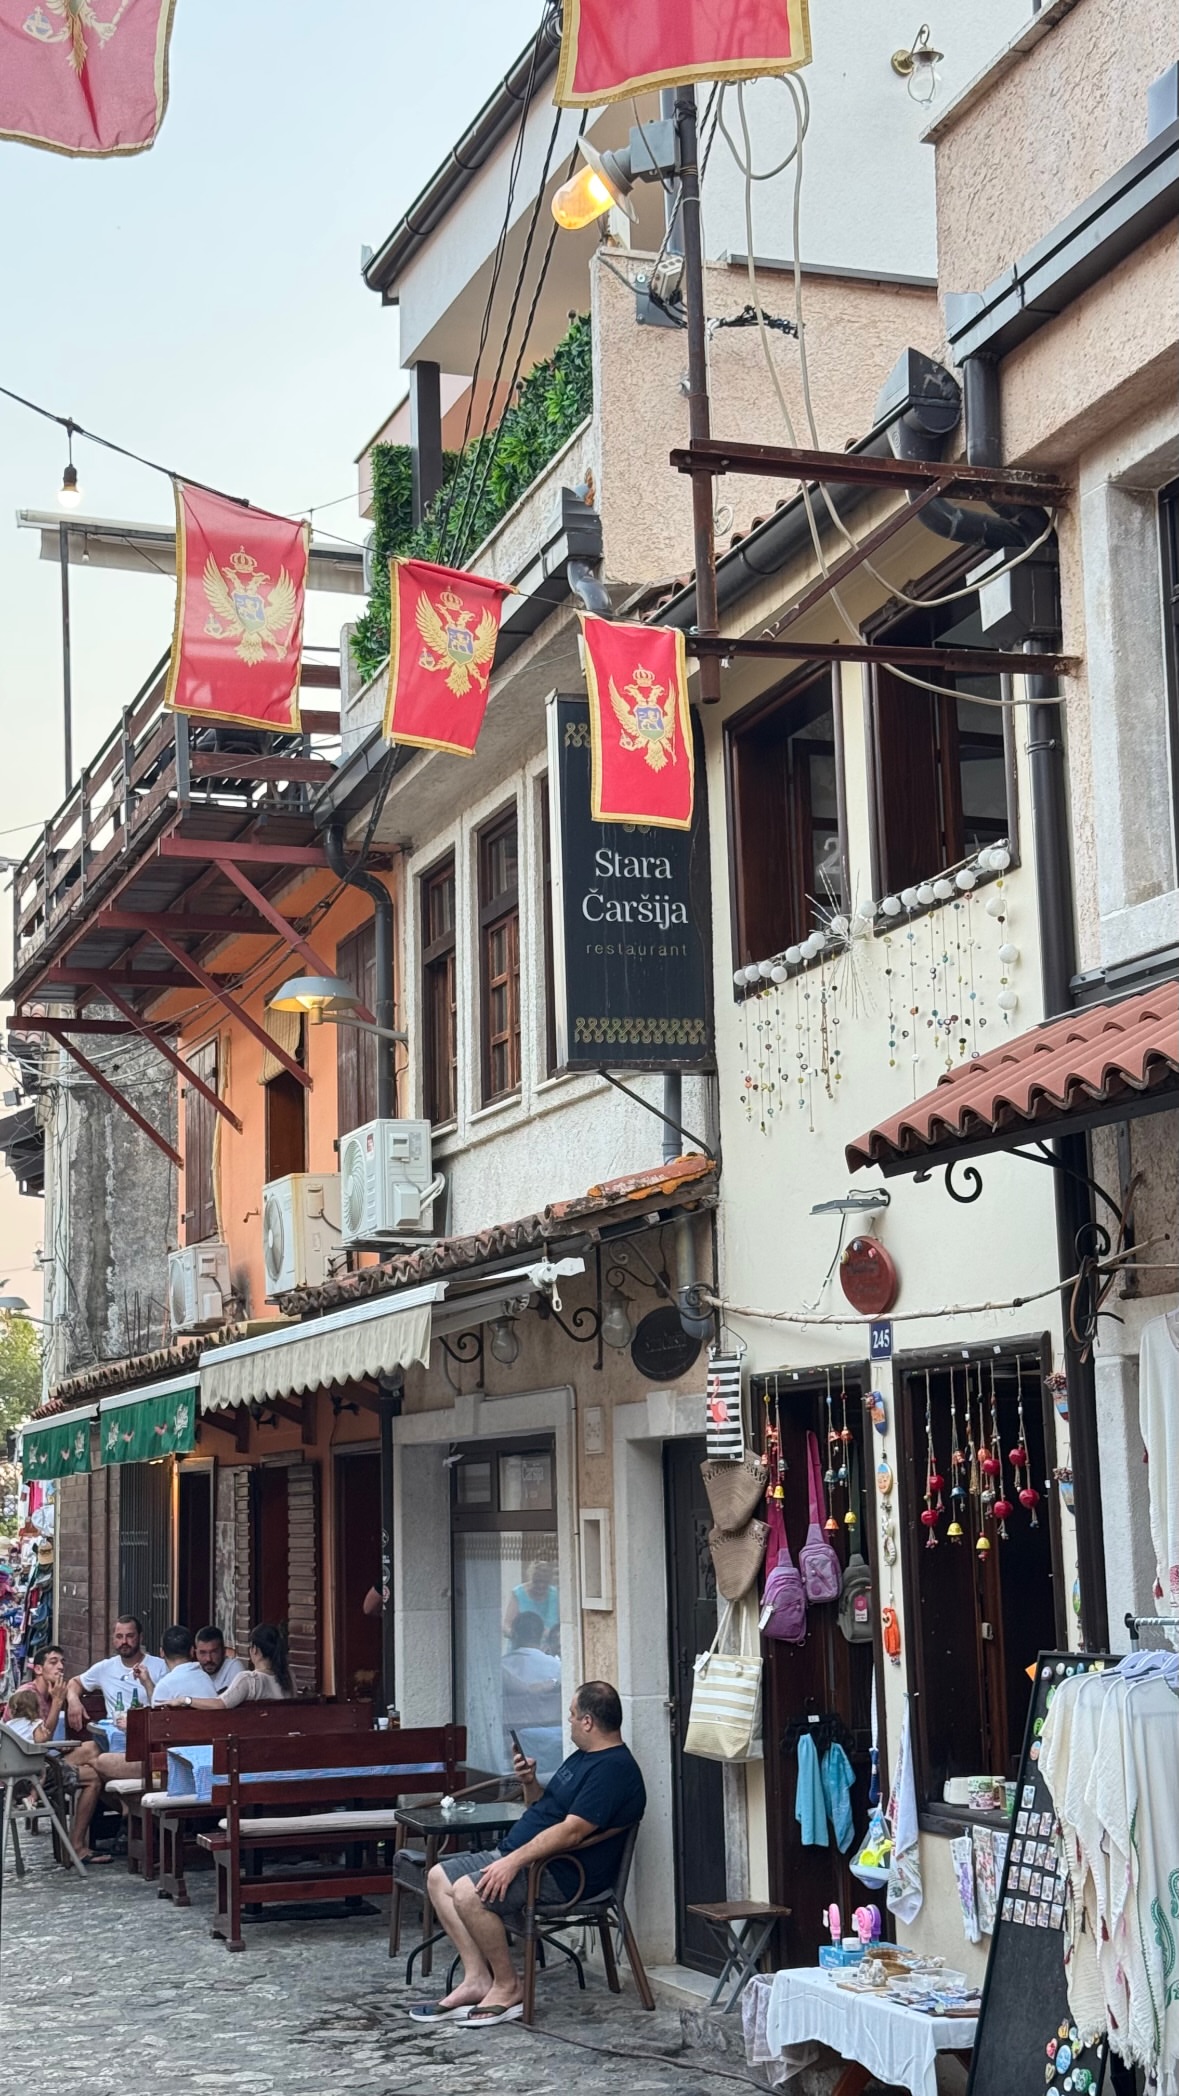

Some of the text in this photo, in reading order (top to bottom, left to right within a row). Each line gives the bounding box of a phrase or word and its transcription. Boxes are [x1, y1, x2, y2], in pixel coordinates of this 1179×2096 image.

[594, 848, 673, 879] Stara
[581, 887, 689, 930] Čaršija
[586, 943, 688, 957] restaurant
[872, 1328, 890, 1349] 245
